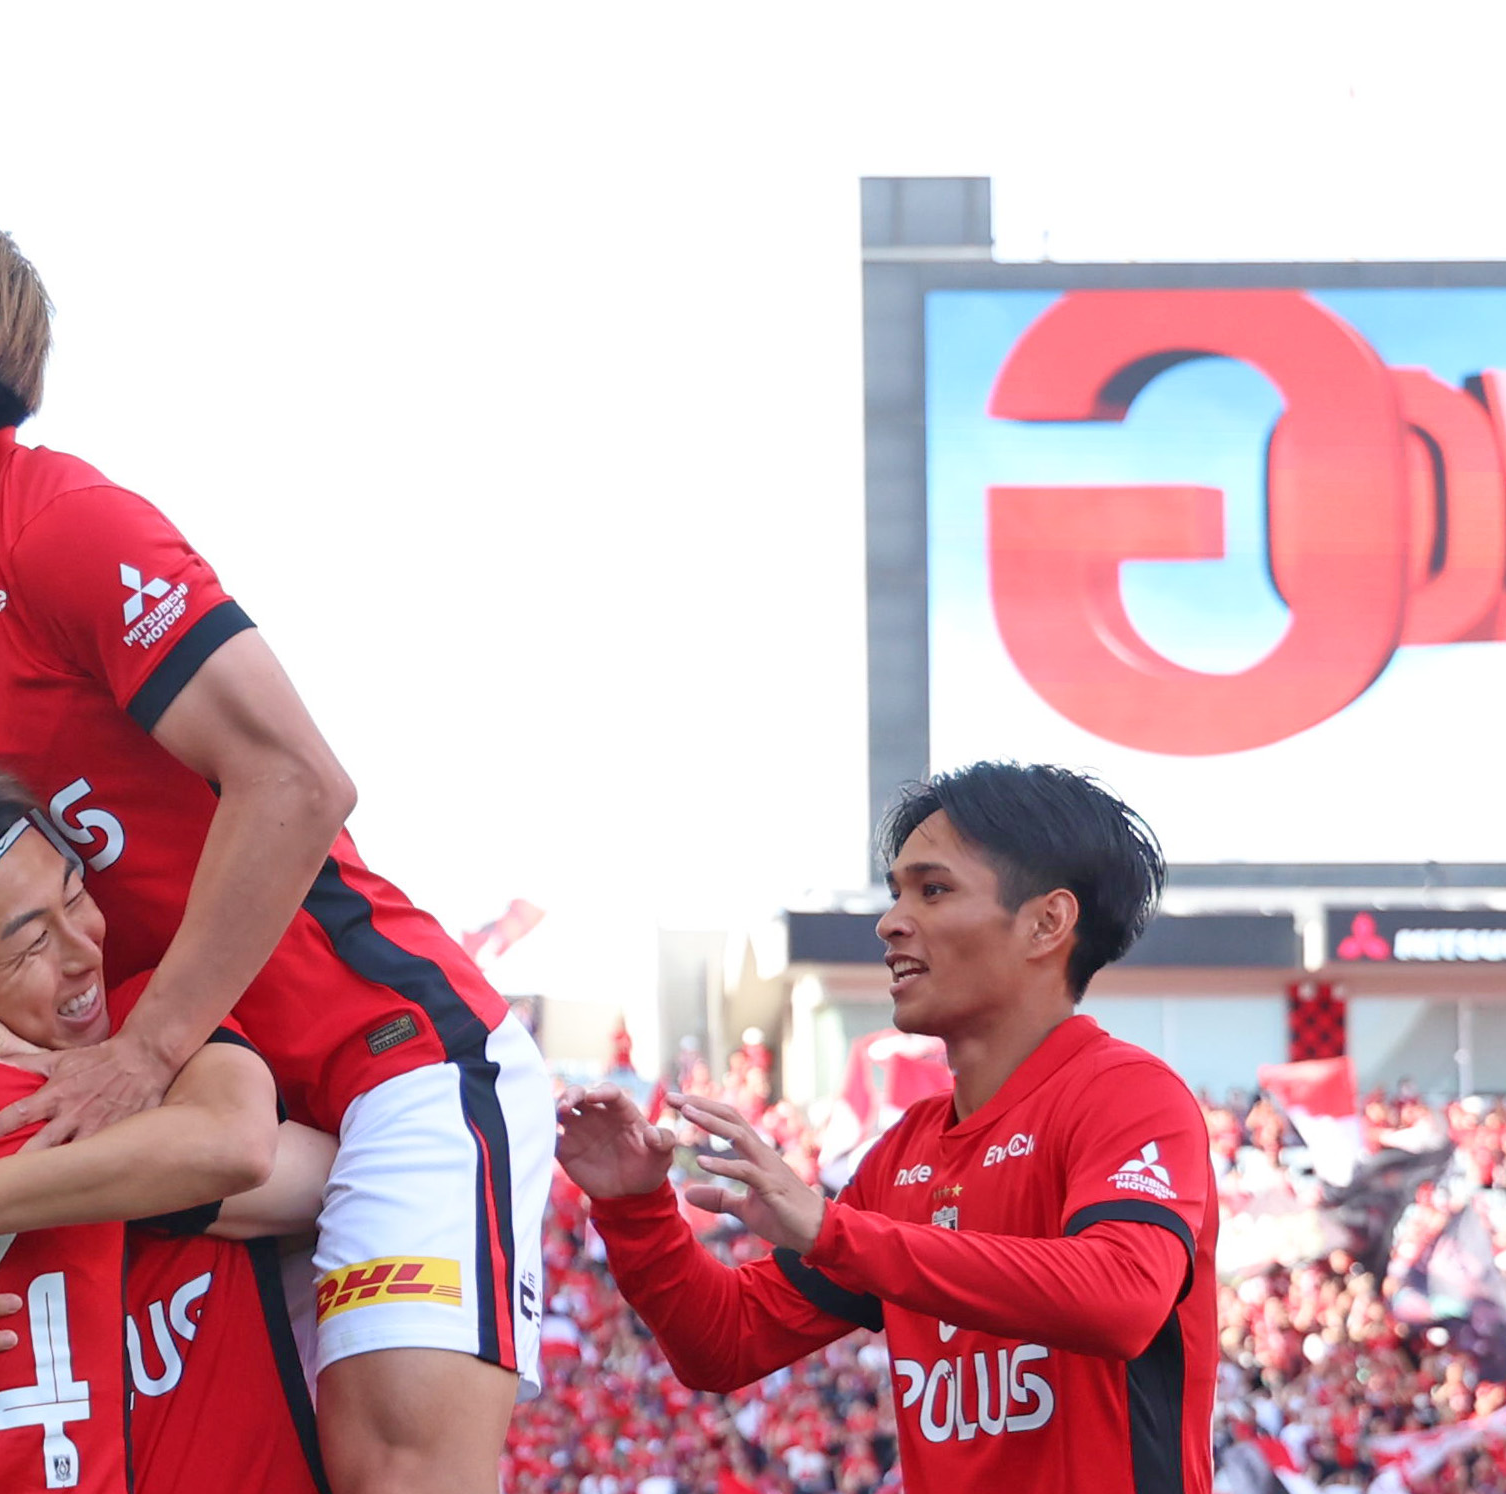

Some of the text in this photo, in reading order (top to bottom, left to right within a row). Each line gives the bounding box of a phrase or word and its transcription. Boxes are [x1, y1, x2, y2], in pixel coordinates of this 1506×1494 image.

[122, 582, 189, 648] MITSUBISHI
[139, 599, 187, 649] MOTORS
[1394, 928, 1506, 962] MITSU
[1107, 1171, 1178, 1200] MITSUBISHI
[1115, 1180, 1170, 1200] MOTORS
[316, 1263, 435, 1321] DHL
[894, 1343, 1056, 1443] POLUS
